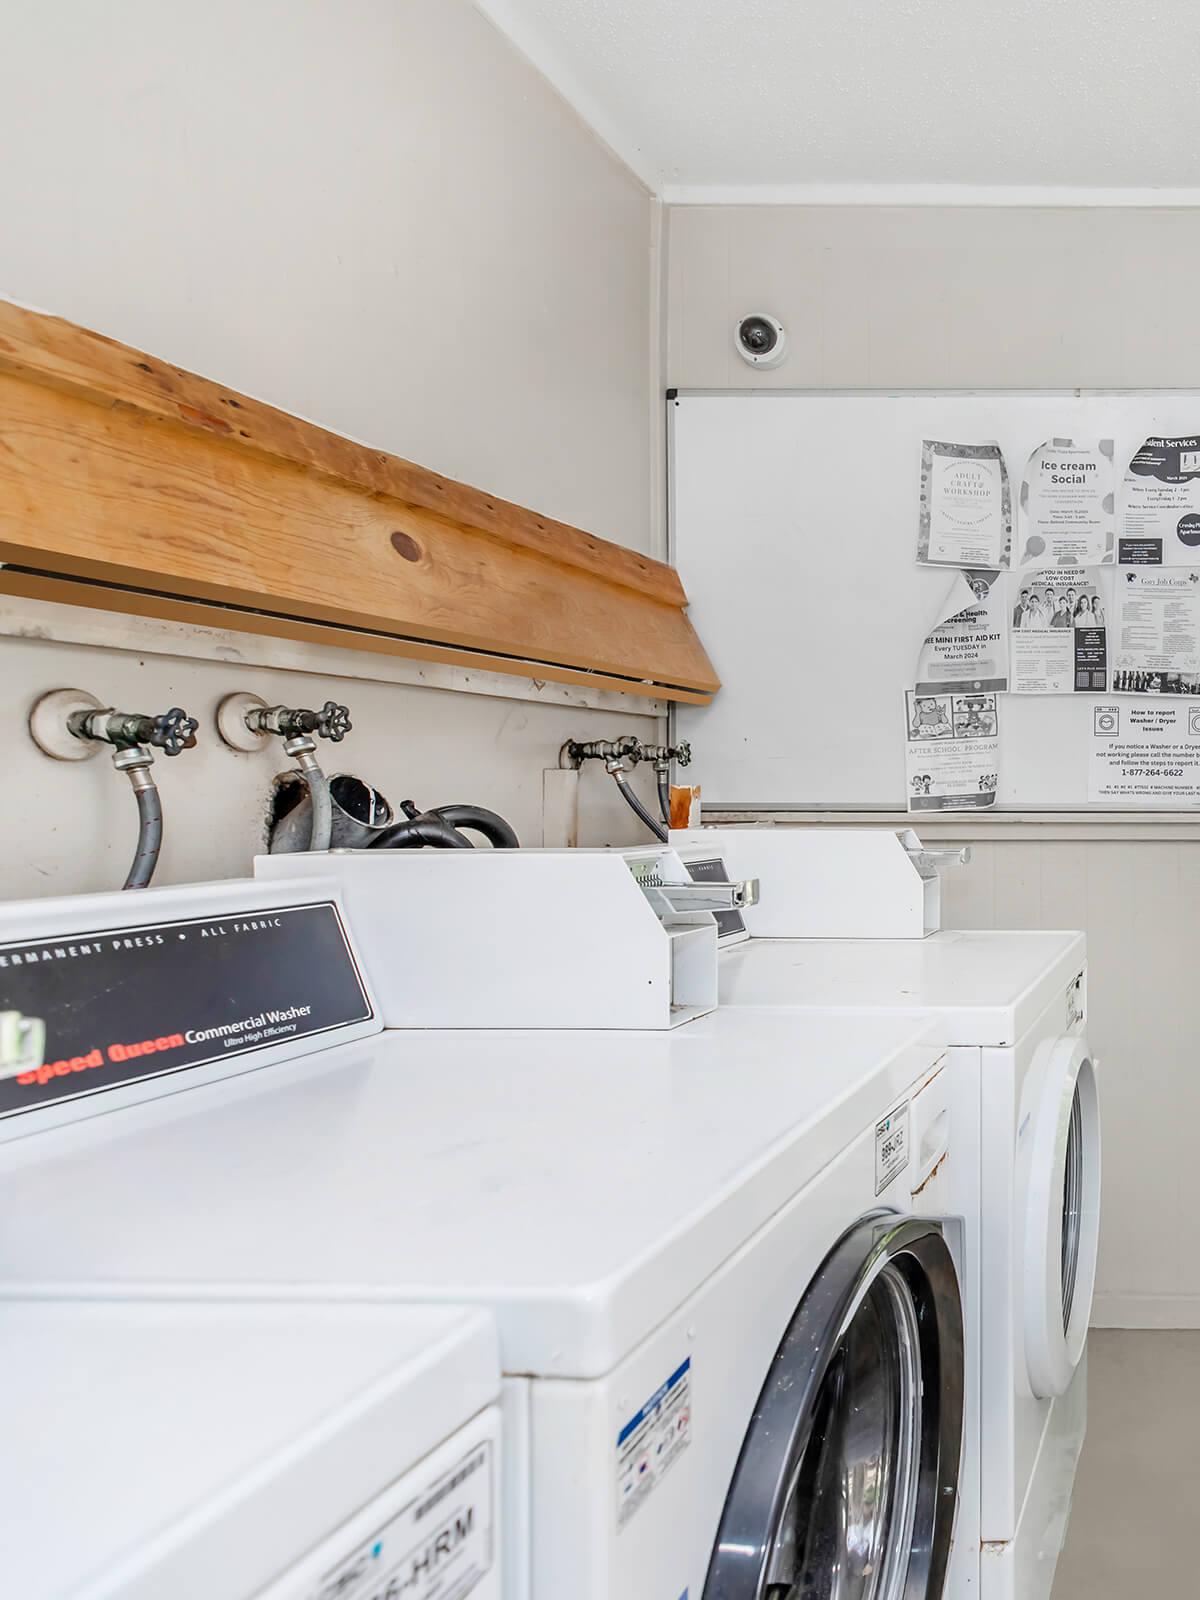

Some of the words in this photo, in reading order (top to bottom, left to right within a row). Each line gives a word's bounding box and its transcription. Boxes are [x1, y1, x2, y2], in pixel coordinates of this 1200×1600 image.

[1166, 439, 1198, 448] Services
[1041, 460, 1058, 470] Ice
[1051, 474, 1086, 484] Social
[943, 487, 991, 496] WORKSHOP
[200, 926, 228, 938] ALL
[234, 918, 282, 933] FABRIC
[0, 942, 102, 968] ERMANENT
[112, 934, 164, 950] PRESS
[185, 1014, 266, 1044] Commercial
[266, 1006, 311, 1024] Washer
[224, 1037, 244, 1048] Ultra
[244, 1032, 263, 1042] High
[263, 1024, 297, 1037] Efficiency
[107, 1032, 186, 1063] Queen
